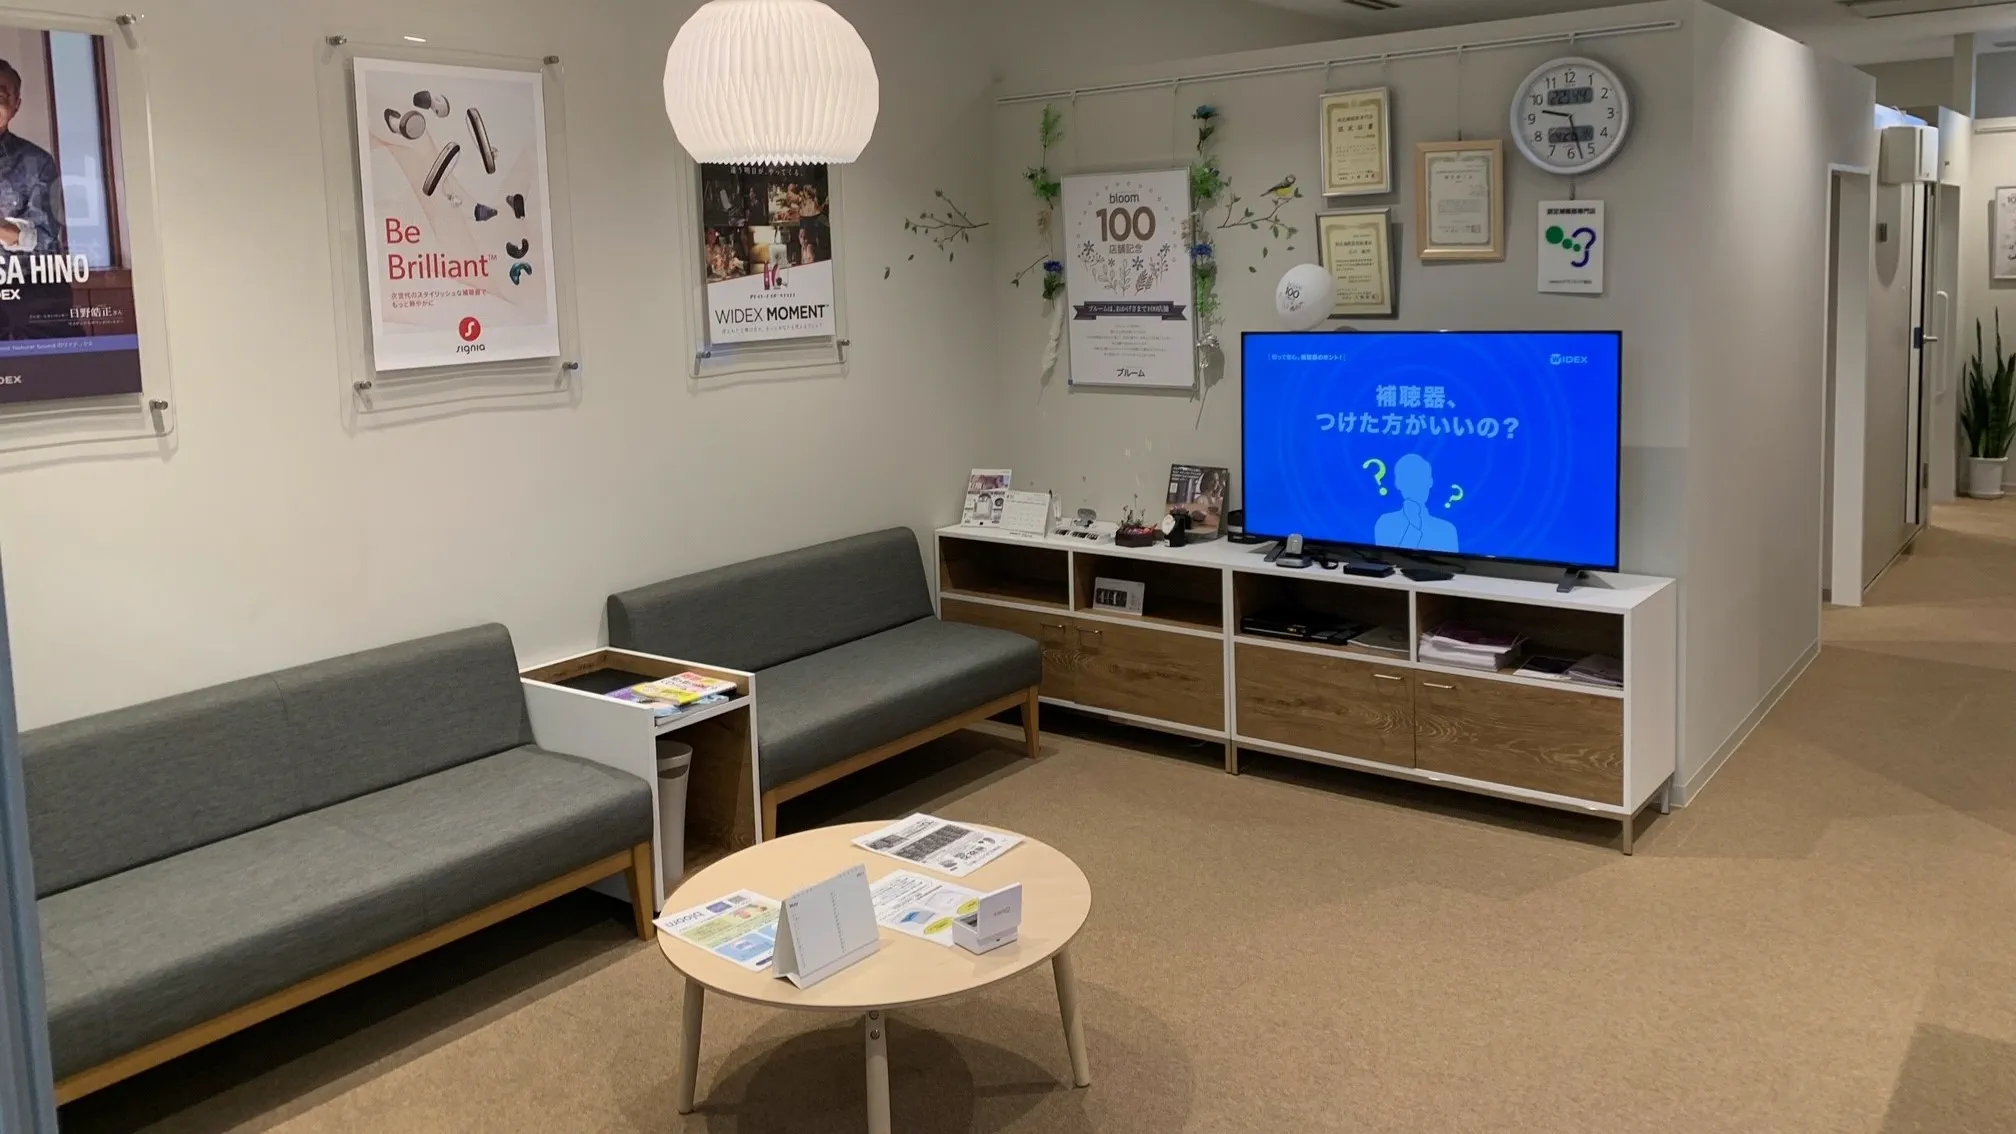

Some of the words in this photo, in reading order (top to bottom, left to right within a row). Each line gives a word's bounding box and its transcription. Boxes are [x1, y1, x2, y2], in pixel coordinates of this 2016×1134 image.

[1546, 77, 1556, 89] 11
[1564, 72, 1576, 84] 12
[1589, 74, 1594, 86] 1
[1600, 87, 1609, 99] 2
[1532, 94, 1543, 106] 10
[1528, 113, 1536, 125] 9
[1607, 107, 1615, 119] 3
[1534, 131, 1543, 142] 8
[1600, 127, 1609, 138] 4
[1548, 145, 1556, 157] 7
[1567, 147, 1575, 159] 6
[1588, 143, 1595, 155] 5
[1109, 193, 1140, 204] bloom
[1096, 206, 1156, 242] 100
[385, 218, 421, 244] Be
[1109, 244, 1143, 254] 店舗記念
[30, 254, 90, 284] HINO
[0, 289, 21, 300] EX
[1284, 286, 1300, 299] 100
[714, 308, 764, 325] WIDEX
[456, 343, 486, 355] signia
[1550, 353, 1588, 365] WIDEX
[1116, 368, 1146, 378] ブルーム
[1375, 384, 1456, 408] 補聴器、
